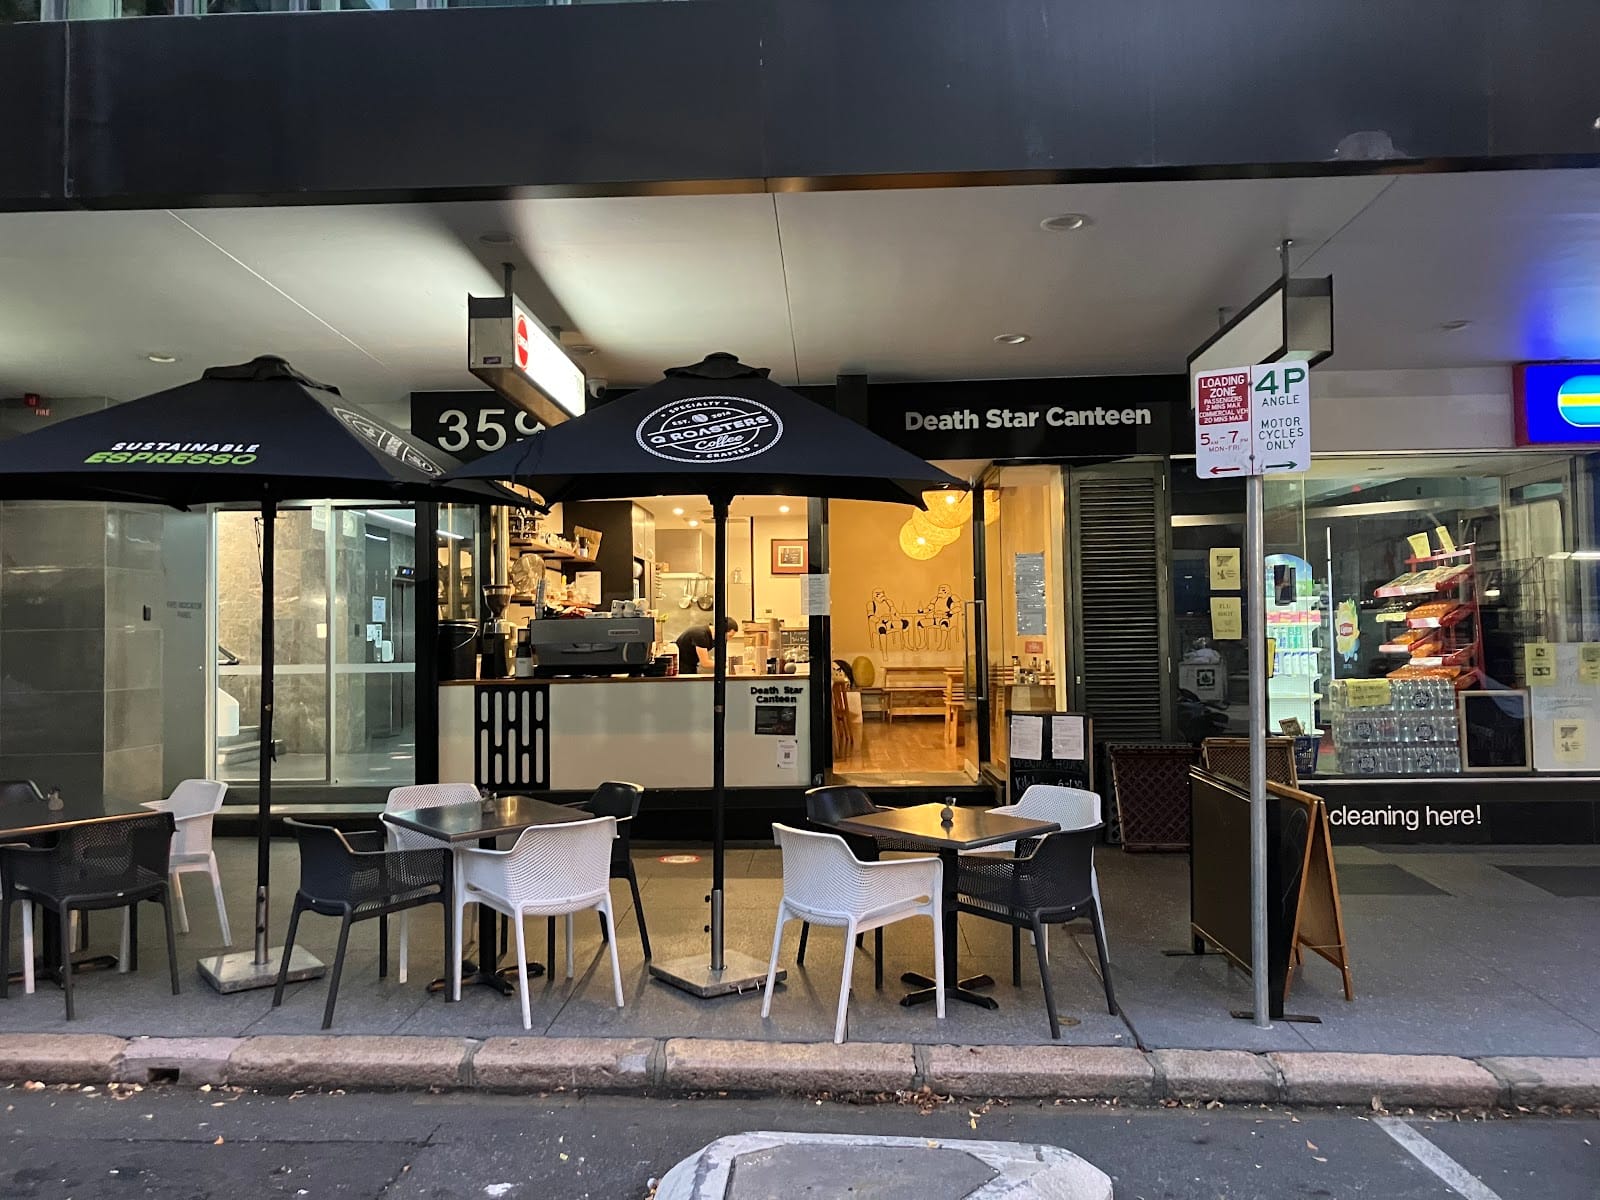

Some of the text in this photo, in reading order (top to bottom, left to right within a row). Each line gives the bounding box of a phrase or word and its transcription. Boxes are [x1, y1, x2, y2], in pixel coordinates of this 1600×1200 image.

[1201, 375, 1245, 389] LOADING
[1255, 368, 1305, 395] 4P
[1210, 386, 1237, 398] ZONE
[1204, 396, 1242, 405] PASSENGERS
[1262, 395, 1300, 407] ANGLE
[669, 401, 720, 413] SPECIALTY
[905, 407, 1151, 431] Death Star Canteen
[1199, 410, 1235, 418] COMMERCIAL
[670, 415, 769, 441] ROASTERS
[1261, 417, 1300, 429] MOTOR
[1258, 427, 1304, 441] CYCLES
[111, 442, 260, 453] SUSTAINABLE
[695, 434, 744, 450] Coffee
[1266, 439, 1296, 450] ONLY
[84, 451, 257, 465] ESPRESSO
[706, 446, 750, 459] CRAFTED
[750, 686, 804, 694] Death Star
[756, 695, 797, 703] Canteen
[1425, 804, 1482, 826] here!
